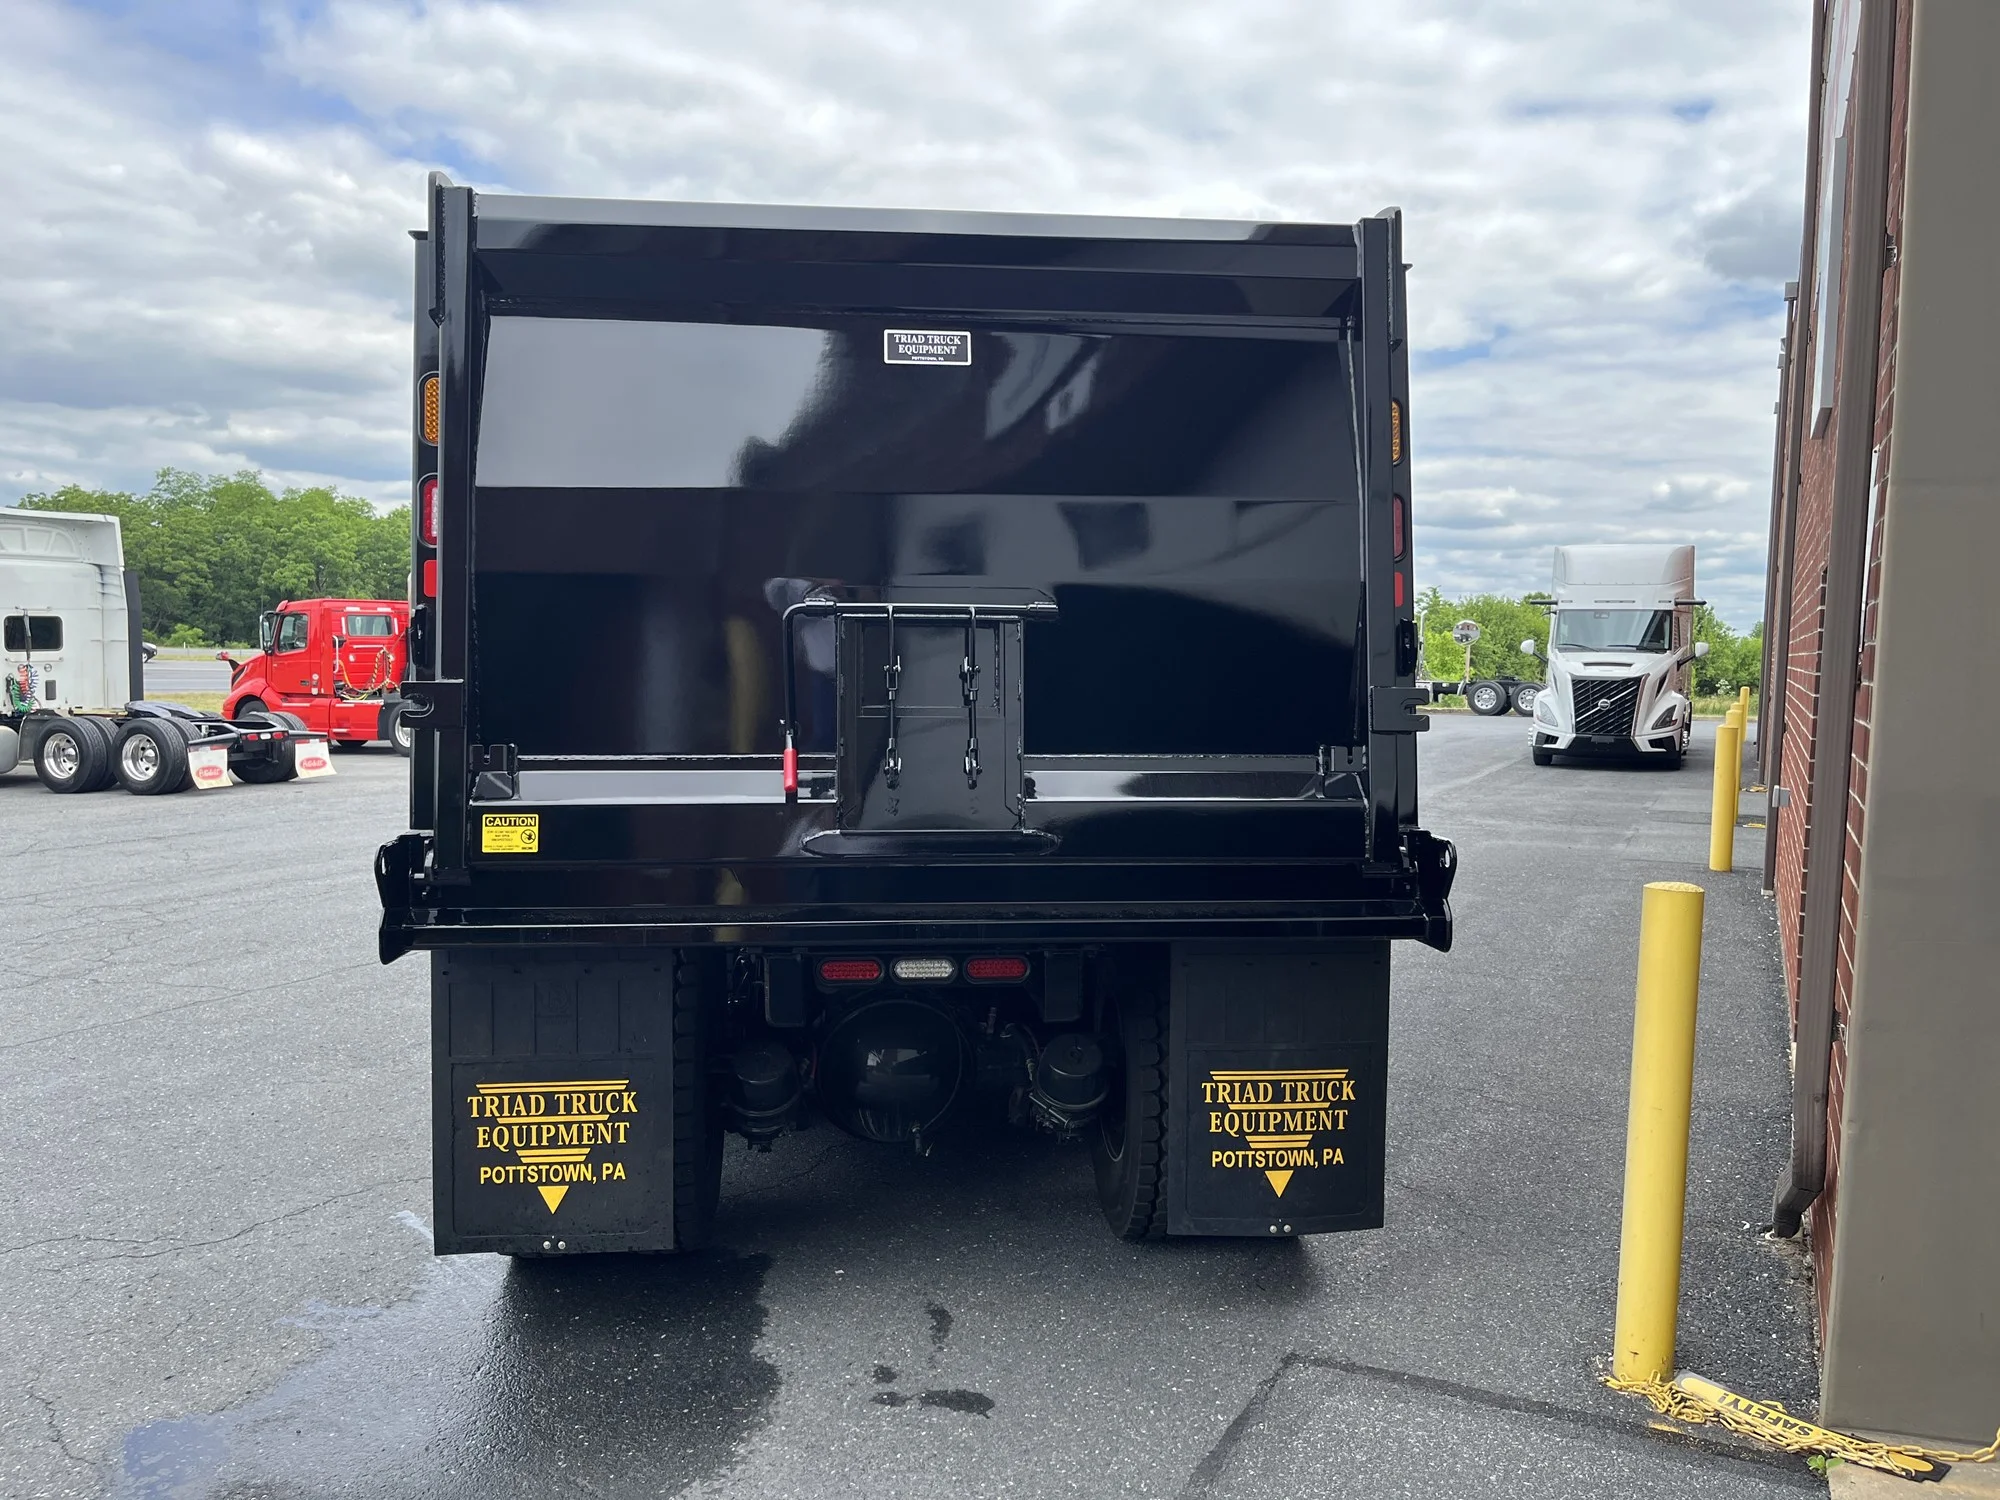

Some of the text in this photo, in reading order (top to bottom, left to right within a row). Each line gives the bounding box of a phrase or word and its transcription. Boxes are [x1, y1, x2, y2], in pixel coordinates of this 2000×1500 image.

[894, 334, 961, 345] TRIAD TRUCK
[898, 344, 957, 355] EQUIPMENT
[486, 817, 535, 826] CAUTION
[1201, 1080, 1356, 1103] TRIAD TRUCK
[467, 1091, 638, 1118] TRIAD TRUCK
[1209, 1109, 1349, 1137] EQUIPMENT
[477, 1122, 630, 1152] EQUIPMENT
[1211, 1148, 1345, 1168] POTTSTOWN, PA
[480, 1162, 626, 1184] POTTSTOWN, PA
[1717, 1393, 1814, 1436] SAFETY!
